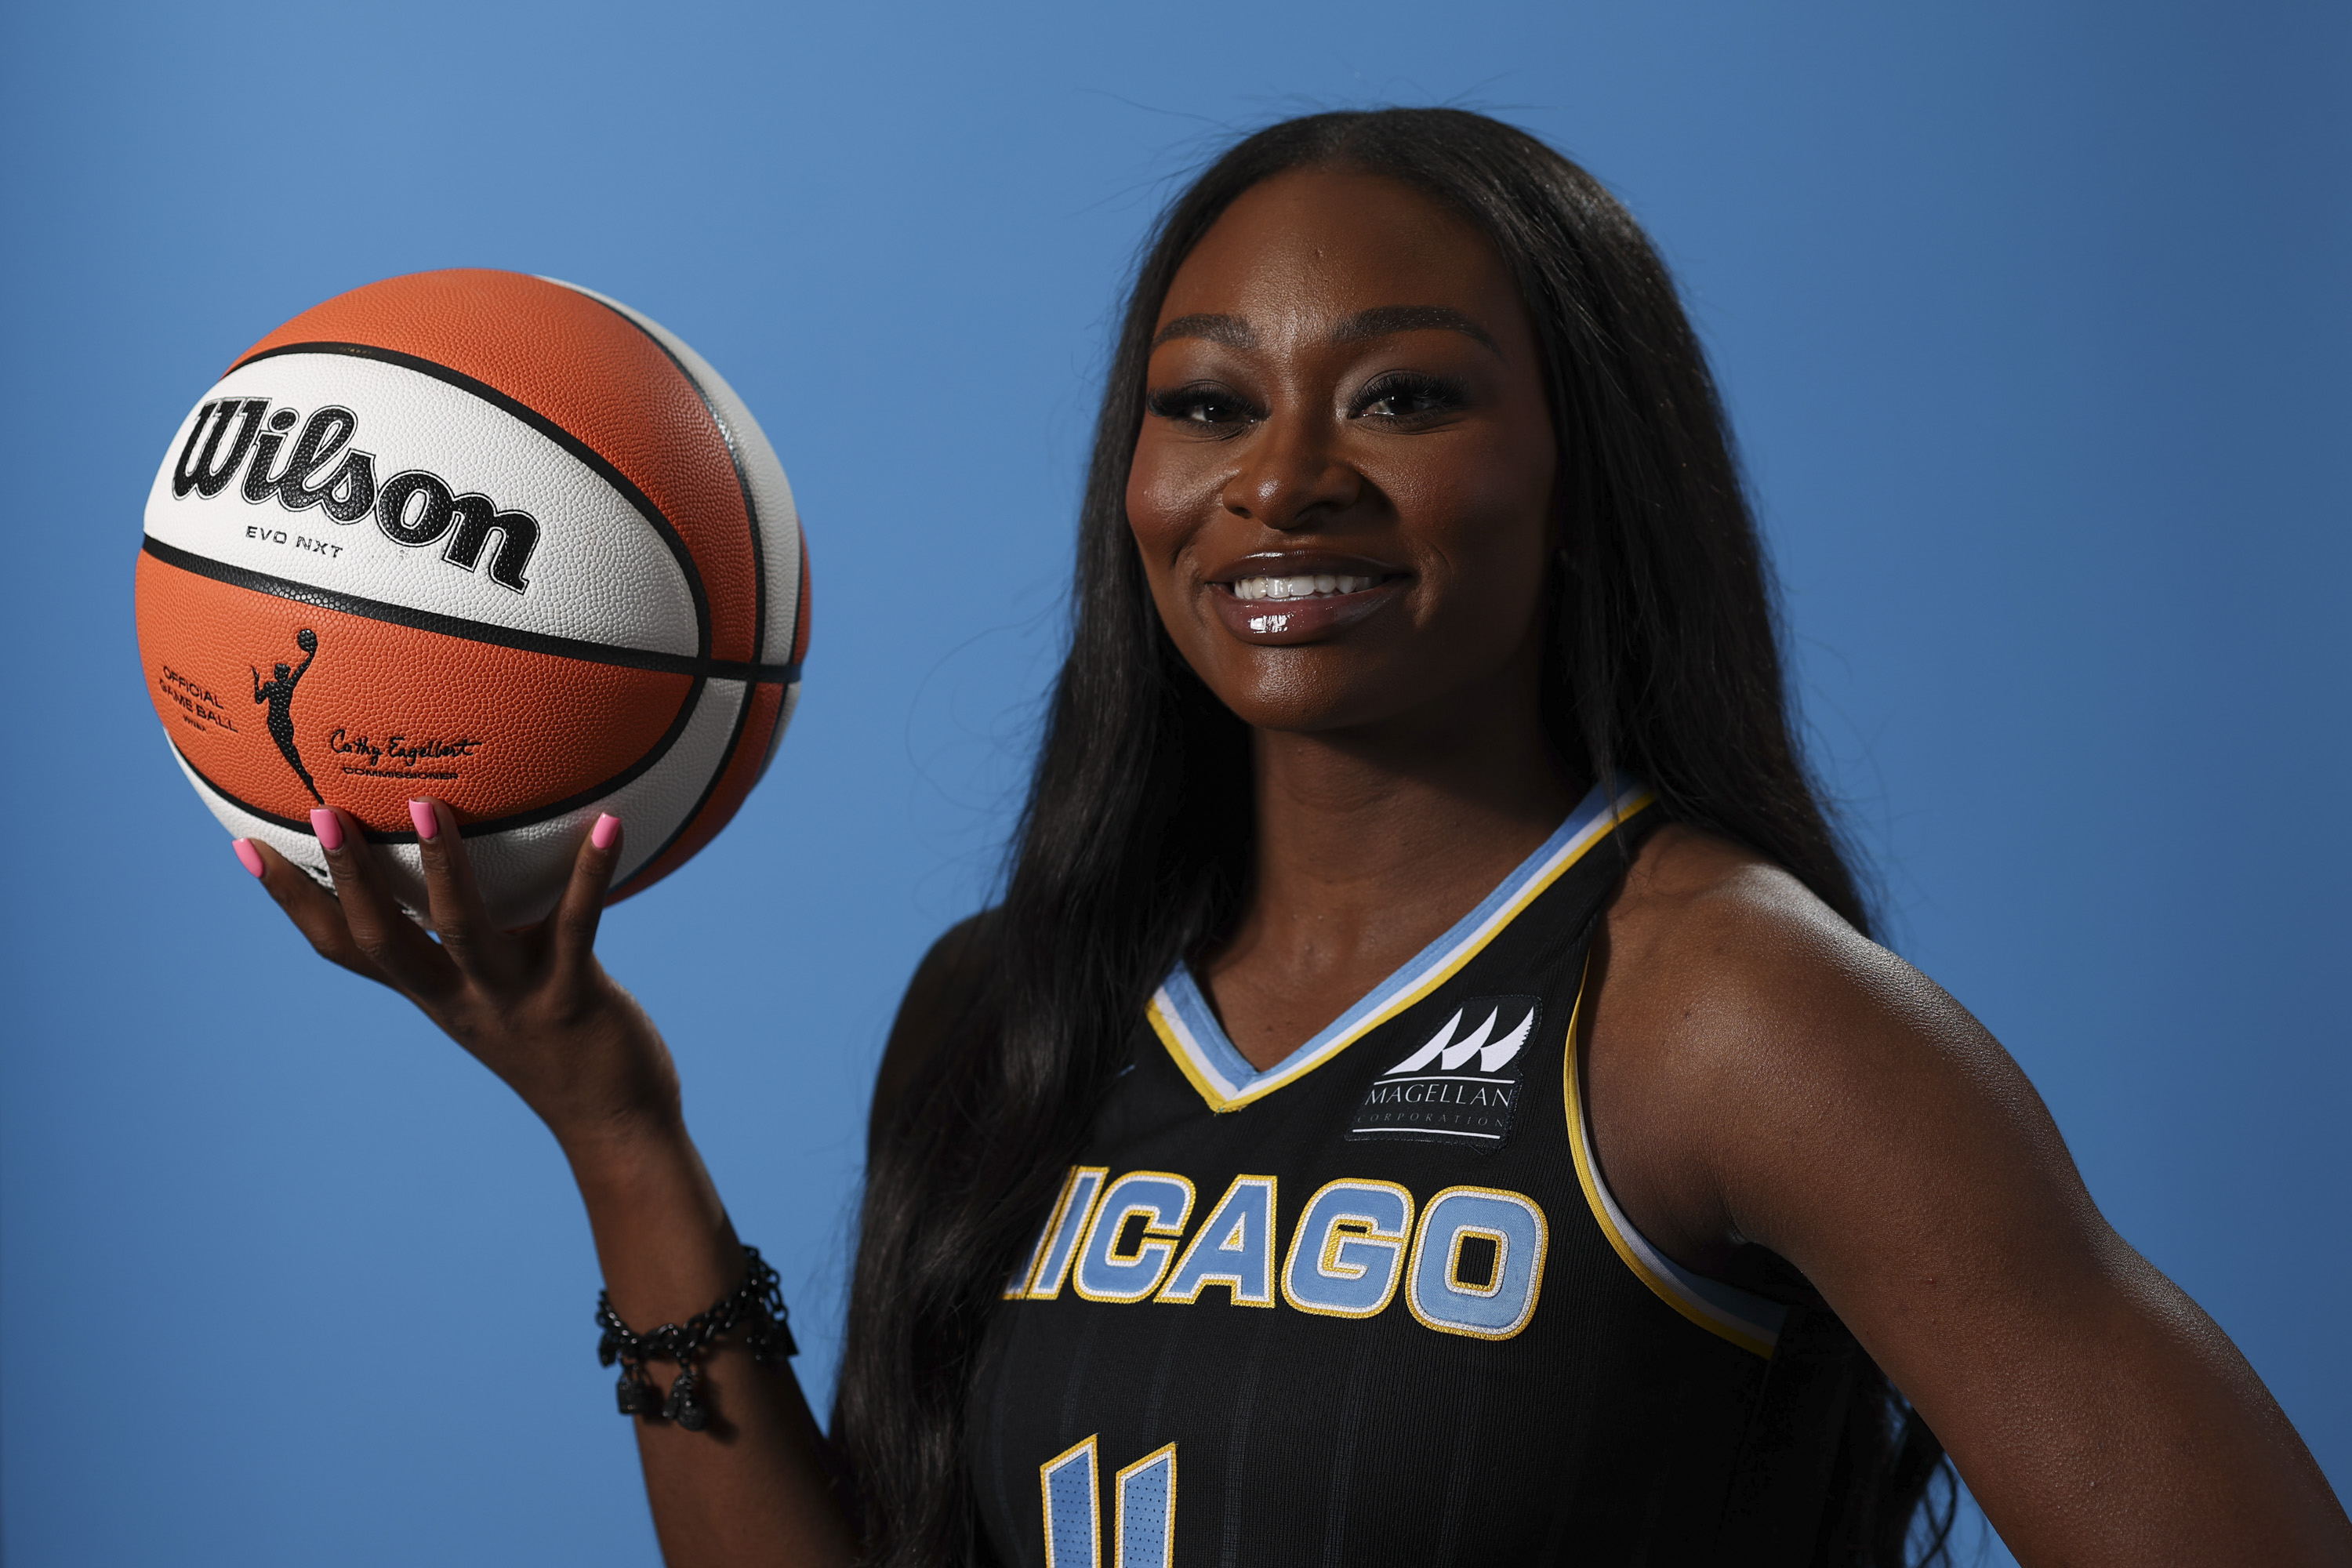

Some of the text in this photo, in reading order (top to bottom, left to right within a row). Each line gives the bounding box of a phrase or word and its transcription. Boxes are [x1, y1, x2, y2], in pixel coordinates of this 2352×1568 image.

[172, 397, 540, 596] Wilson
[245, 525, 343, 559] EVO NXT
[159, 677, 194, 713] GAME
[196, 704, 239, 734] BALL
[162, 665, 225, 710] OFFICIAL
[330, 728, 383, 767] Cathy
[343, 766, 459, 781] COMMISSIONER
[1364, 1083, 1513, 1108] MAGELLAN
[1356, 1111, 1504, 1128] CORPORATION
[1000, 1164, 1551, 1341] ICAGO
[1040, 1433, 1178, 1568] 11
